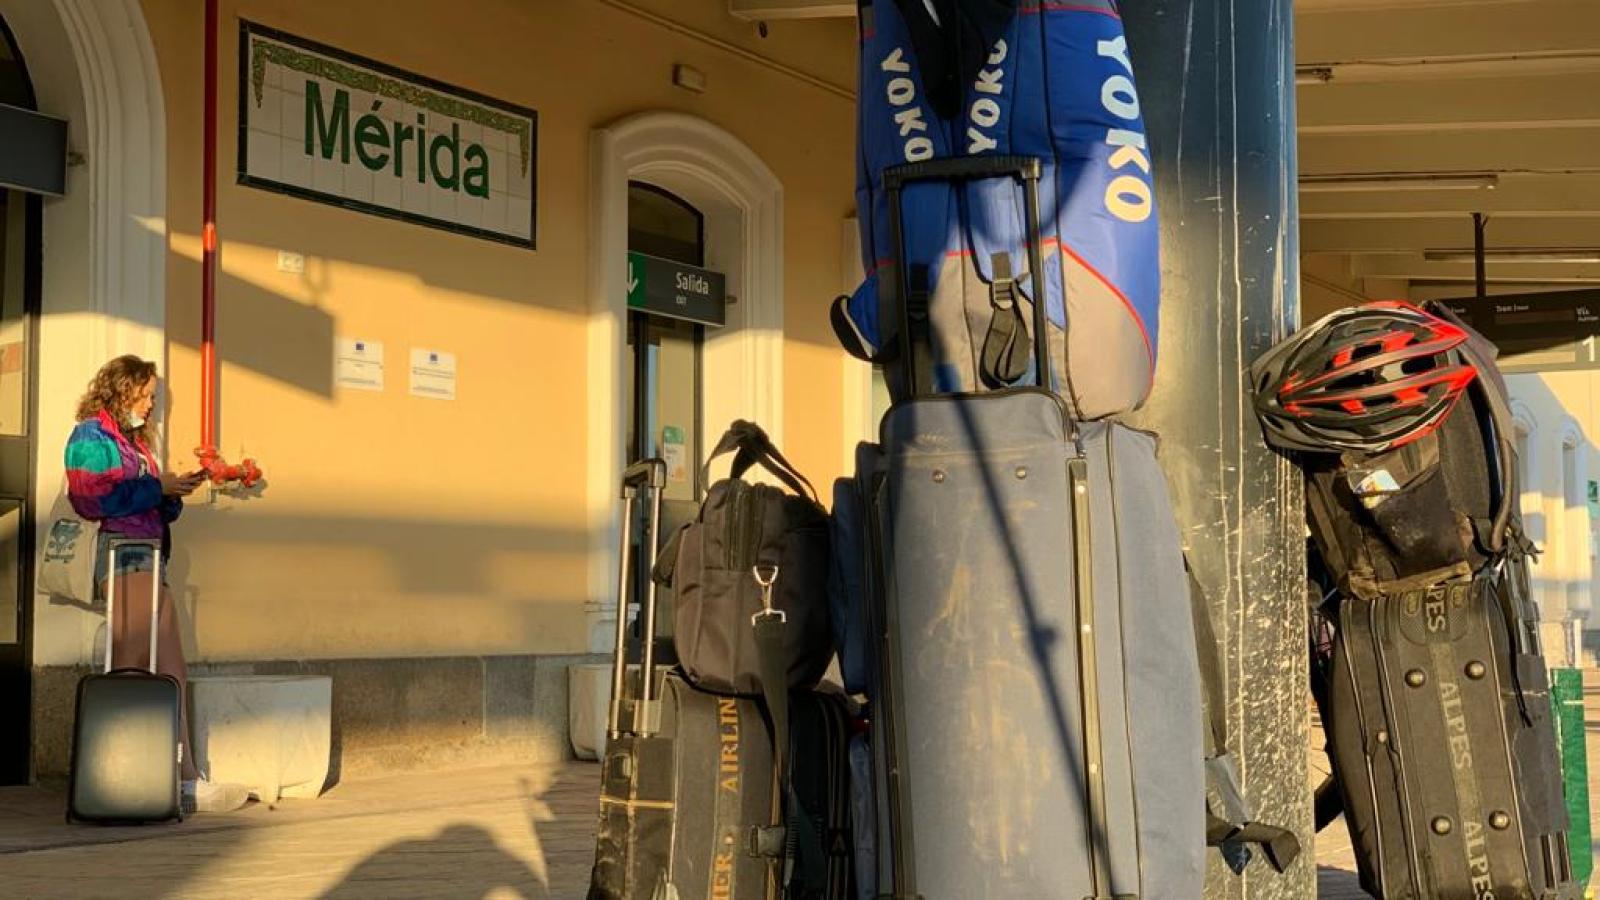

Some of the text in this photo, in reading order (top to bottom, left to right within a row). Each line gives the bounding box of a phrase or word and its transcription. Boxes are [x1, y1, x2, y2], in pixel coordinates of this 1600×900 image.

[304, 79, 490, 200] Mérida
[881, 47, 934, 162] YOKO
[1096, 35, 1152, 222] YOKO
[675, 271, 709, 295] Salida
[1582, 334, 1596, 362] 1
[1426, 585, 1446, 632] PES
[1438, 682, 1473, 770] ALPES
